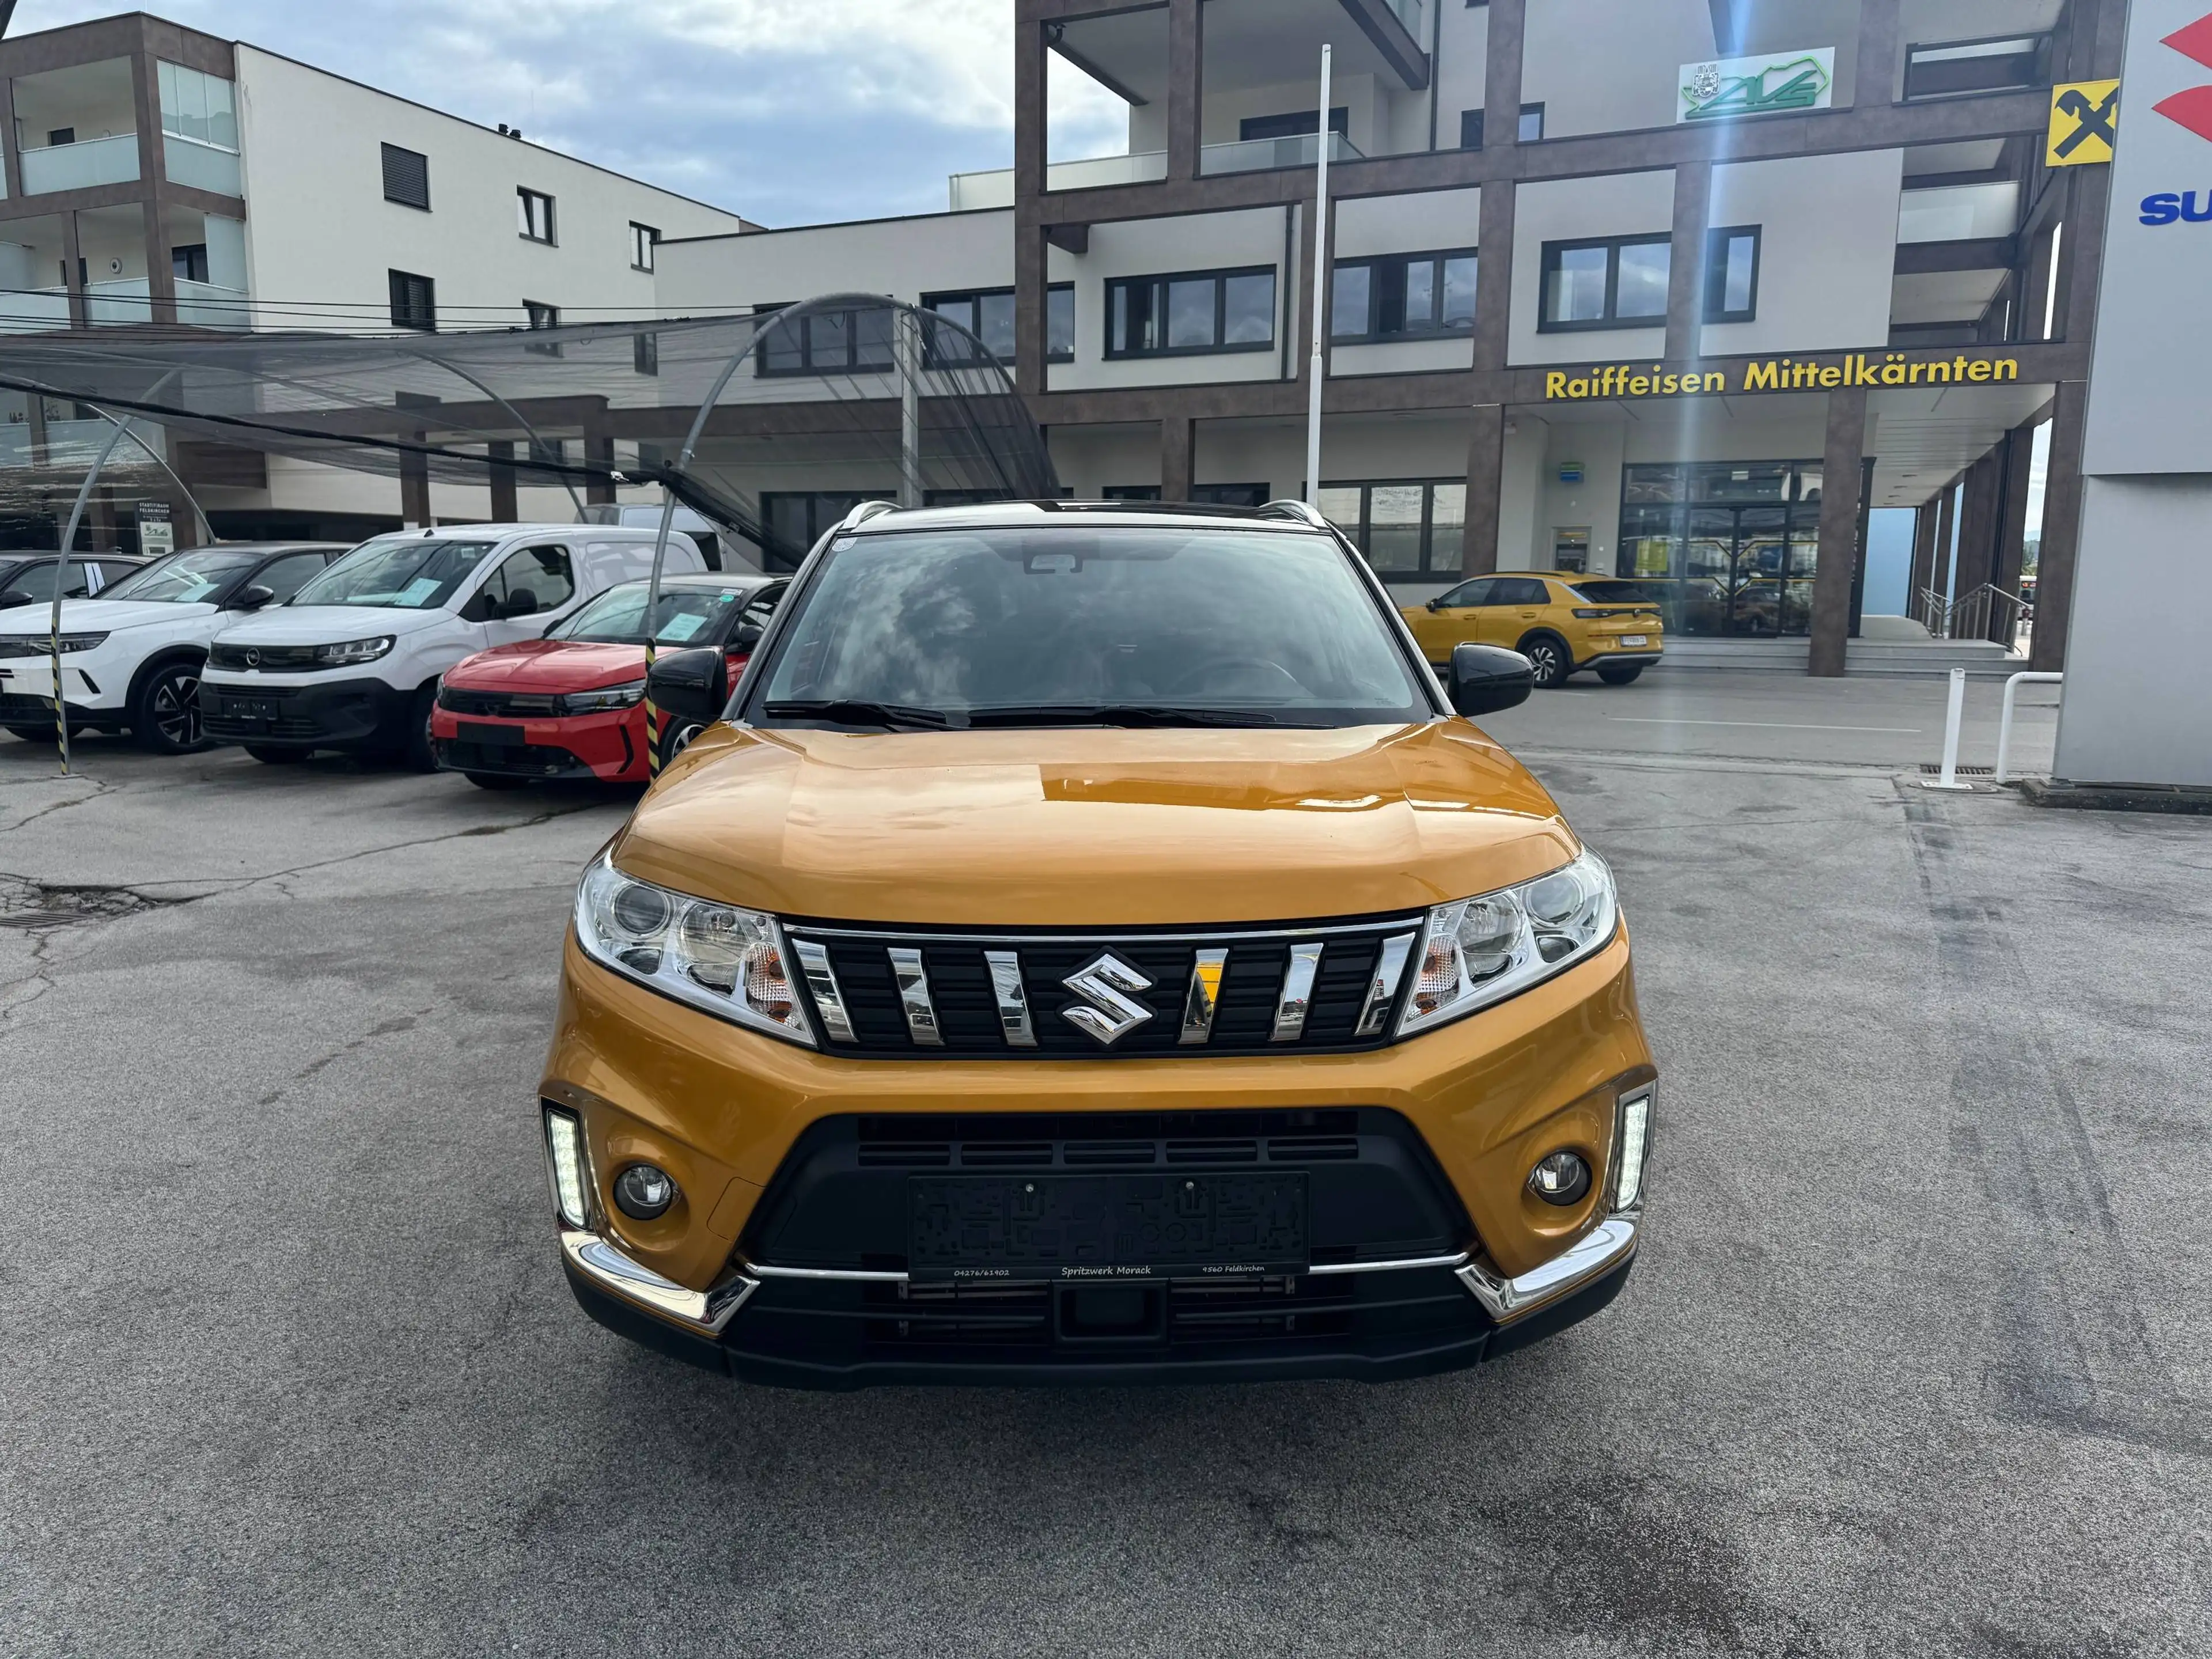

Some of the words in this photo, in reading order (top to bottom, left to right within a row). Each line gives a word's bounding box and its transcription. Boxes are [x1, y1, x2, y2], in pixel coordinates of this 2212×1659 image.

[1546, 364, 1725, 399] Raiffeisen
[1743, 354, 2018, 391] Mittelkärnten
[1061, 1266, 1113, 1278] Spritzwerk
[1116, 1266, 1151, 1274] Morack
